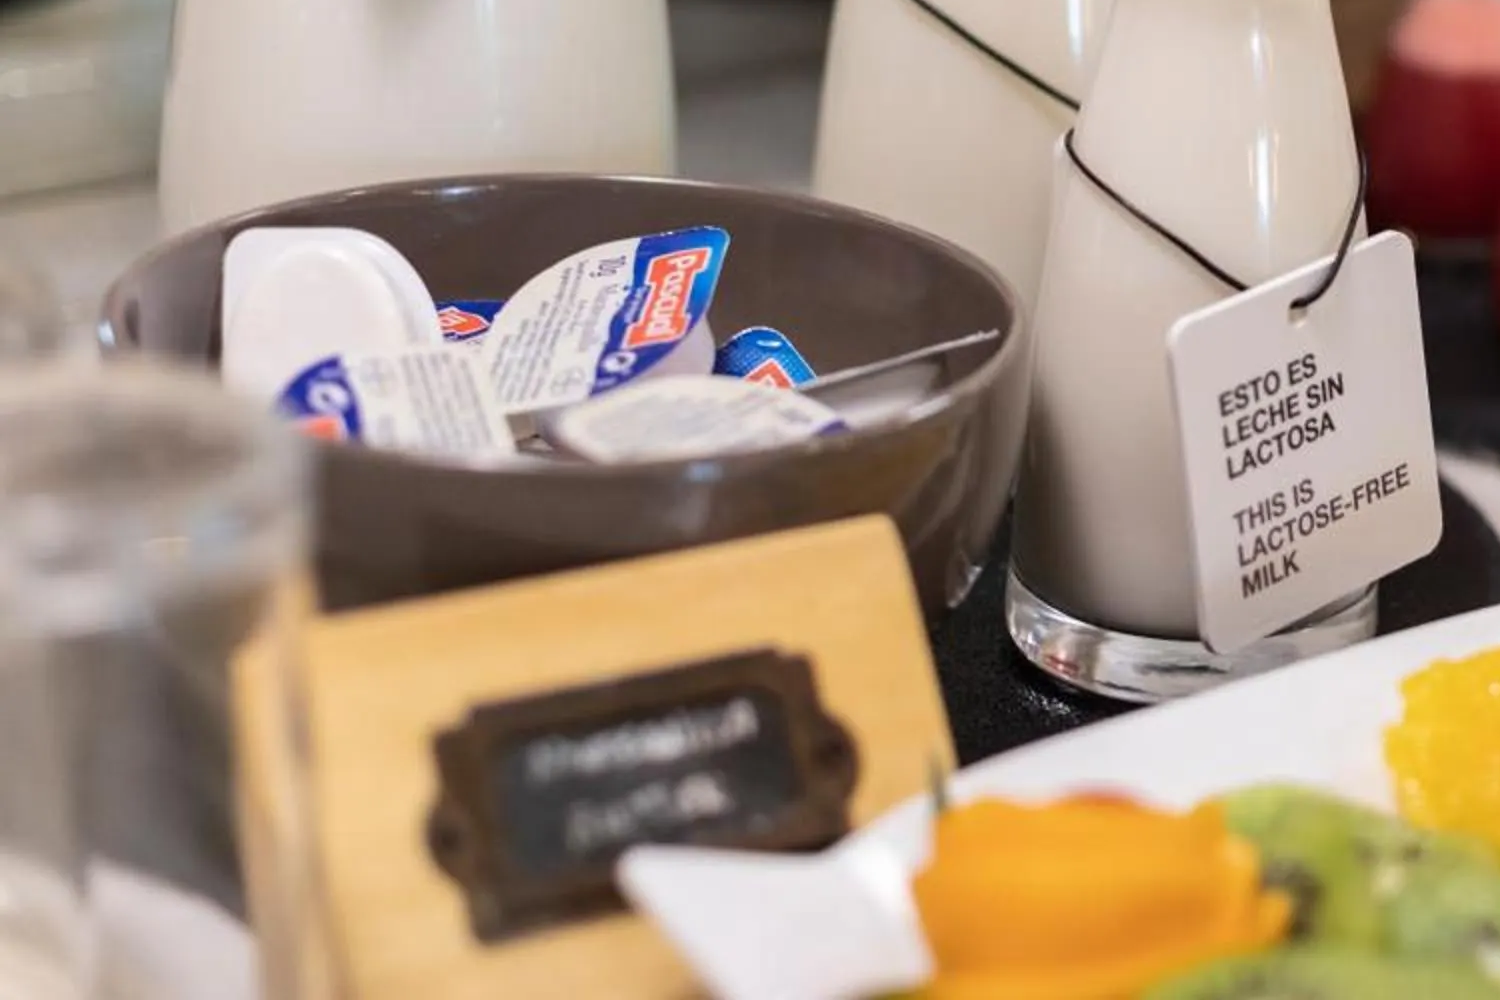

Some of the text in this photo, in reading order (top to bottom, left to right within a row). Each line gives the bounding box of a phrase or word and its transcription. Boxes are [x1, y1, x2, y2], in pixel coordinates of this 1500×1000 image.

[645, 254, 698, 338] Pascual
[1217, 352, 1318, 418] ESTO ES
[1221, 372, 1345, 449] LECHE SIN
[1226, 411, 1336, 481] LACTOSA
[1233, 478, 1316, 536] THIS IS
[1237, 462, 1411, 568] LACTOSE-FREE
[1242, 550, 1301, 599] MILK
